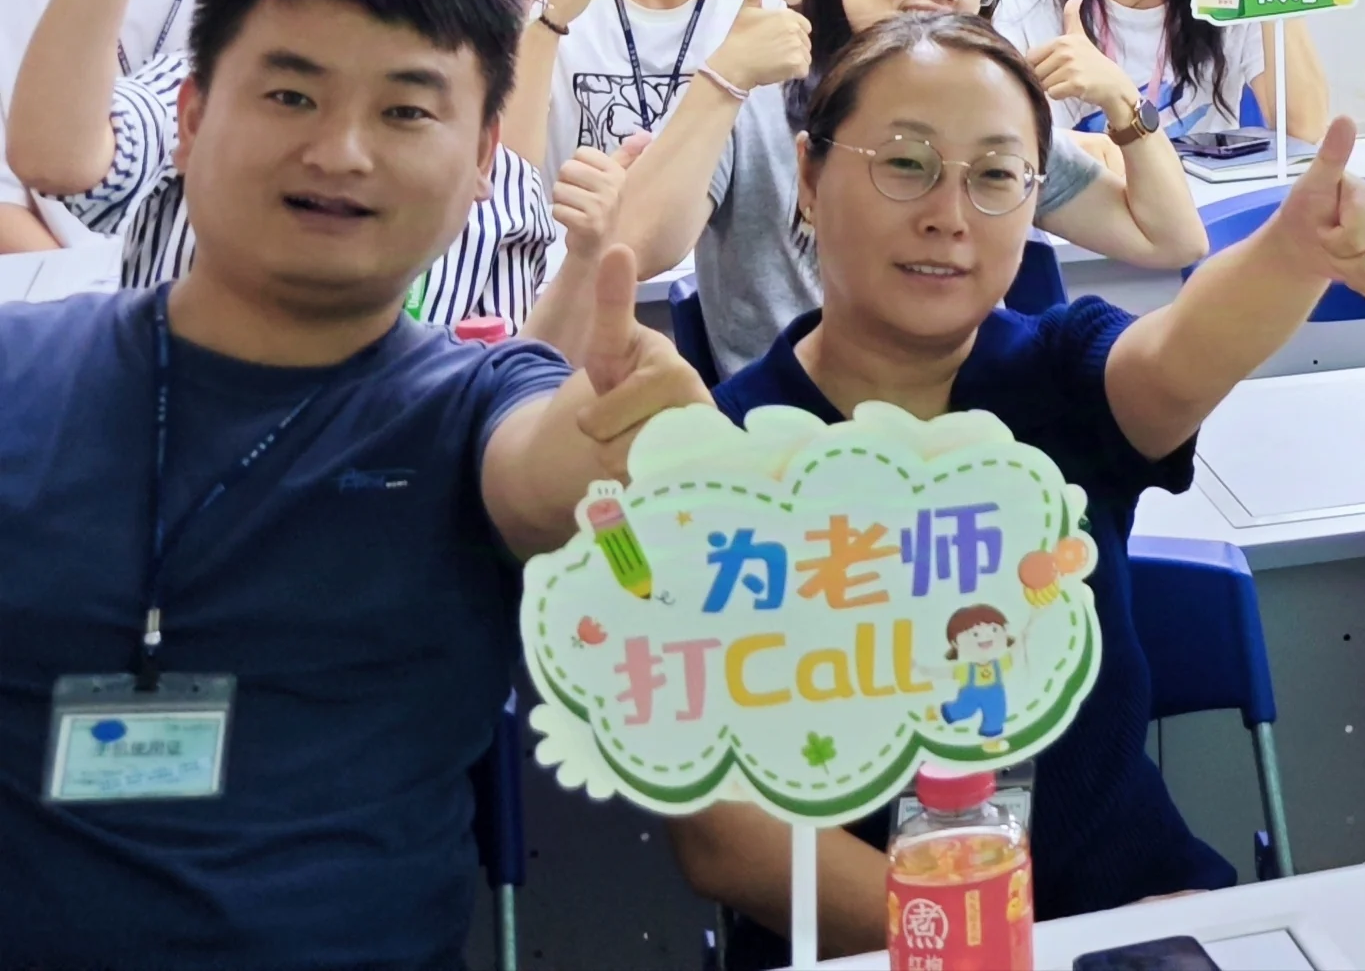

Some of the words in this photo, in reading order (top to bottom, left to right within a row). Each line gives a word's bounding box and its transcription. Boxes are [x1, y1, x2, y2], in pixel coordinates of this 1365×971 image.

[702, 502, 1003, 613] 为老师
[613, 618, 934, 726] 打Call
